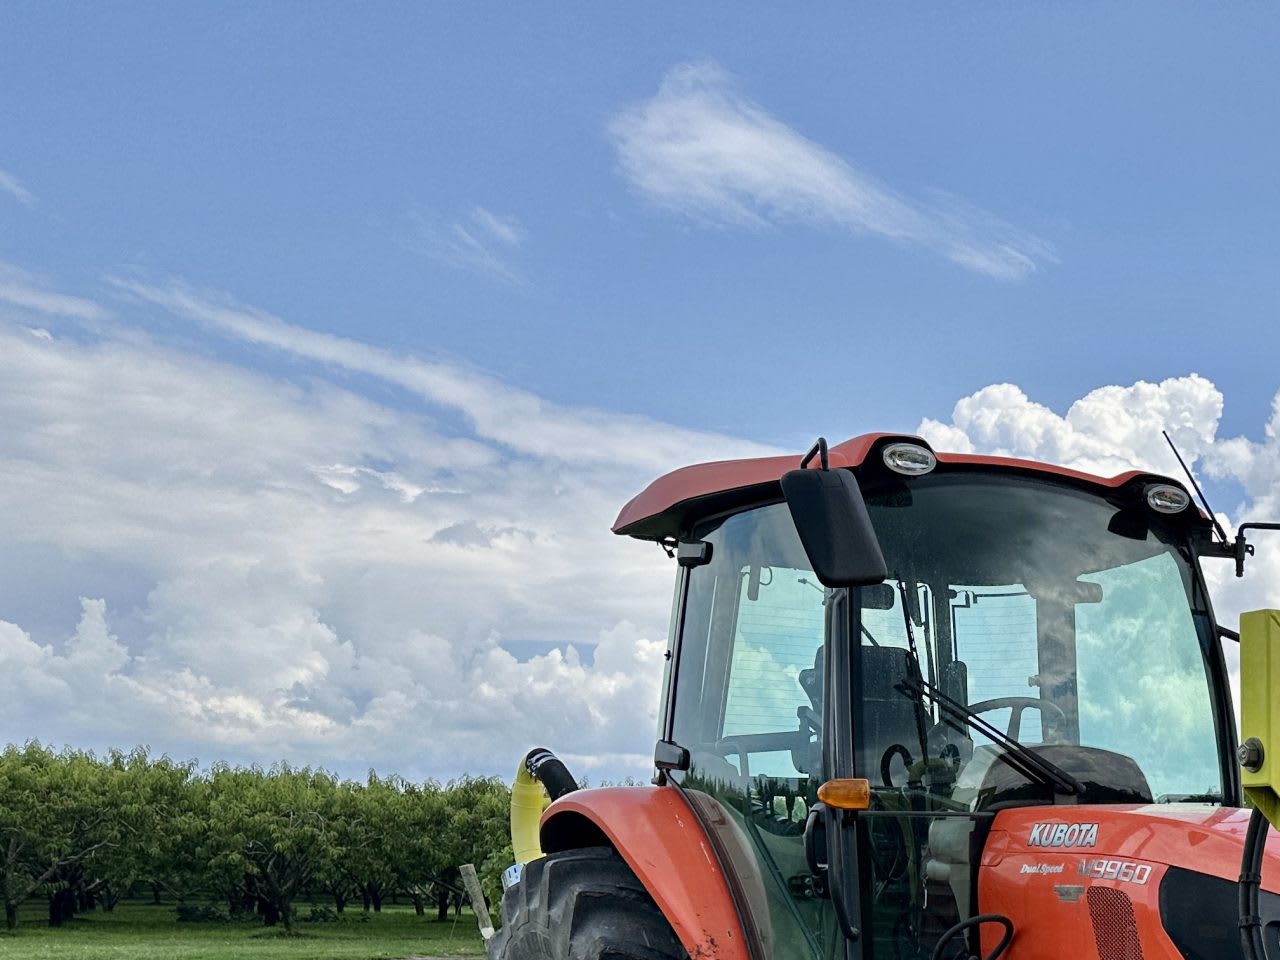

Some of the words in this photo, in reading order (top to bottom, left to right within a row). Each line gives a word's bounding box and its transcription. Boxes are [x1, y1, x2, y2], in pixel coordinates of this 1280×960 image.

[1027, 822, 1099, 848] KUBOTA
[1020, 863, 1041, 874] Dual
[1040, 863, 1065, 876] Speed
[1078, 859, 1152, 885] M9960
